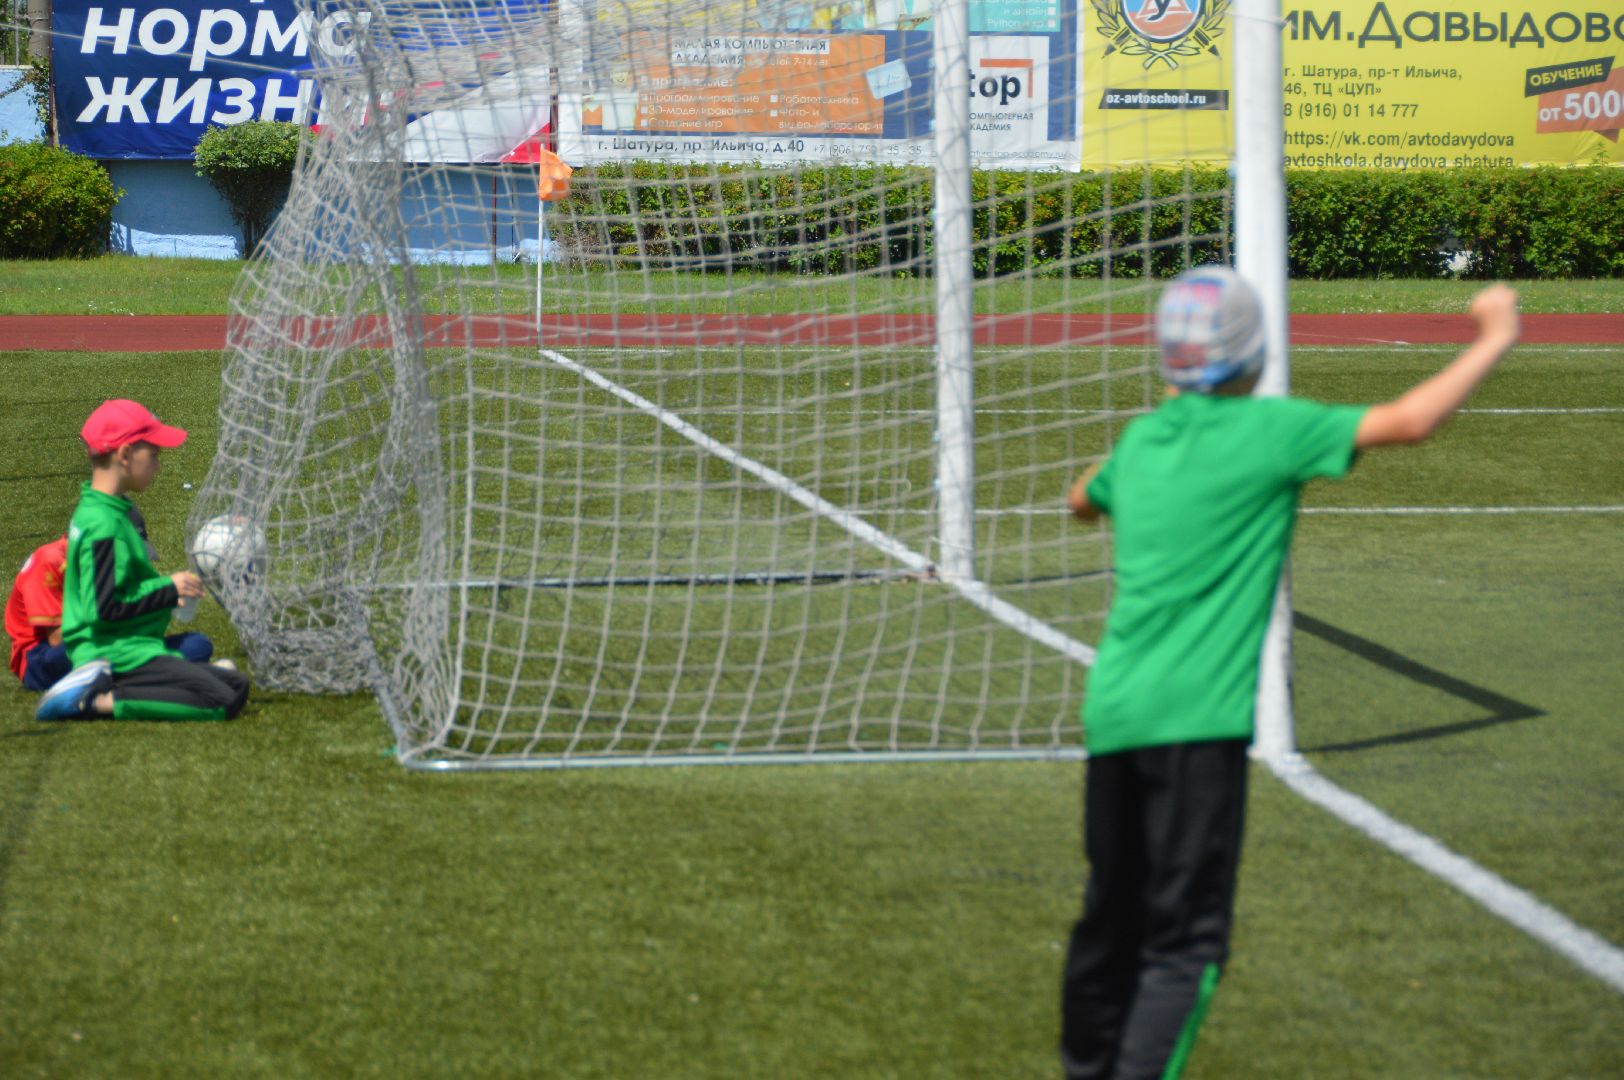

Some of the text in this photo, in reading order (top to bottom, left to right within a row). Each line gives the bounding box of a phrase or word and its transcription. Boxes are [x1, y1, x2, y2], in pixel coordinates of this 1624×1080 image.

[80, 8, 371, 71] норма
[1302, 65, 1362, 80] Шатура,
[1368, 67, 1400, 80] пр-т
[1405, 66, 1462, 80] Ильича,
[1530, 64, 1603, 86] ОБУЧЕНИЕ
[968, 69, 1021, 105] top
[1284, 83, 1382, 97] 46, ТЦ «ЦУП»
[1106, 92, 1206, 104] oz-avtoschool.ru
[1564, 89, 1624, 121] 500
[969, 112, 1034, 121] ОМПЬЮТЕРНАЯ
[1284, 103, 1419, 120] 8 (916) 01 14 777
[970, 123, 1011, 132] КАДЕМИЯ
[613, 138, 678, 152] Шатура,
[712, 139, 768, 153] Ильича,
[1284, 131, 1514, 150] https://vk.com/avtodavydova
